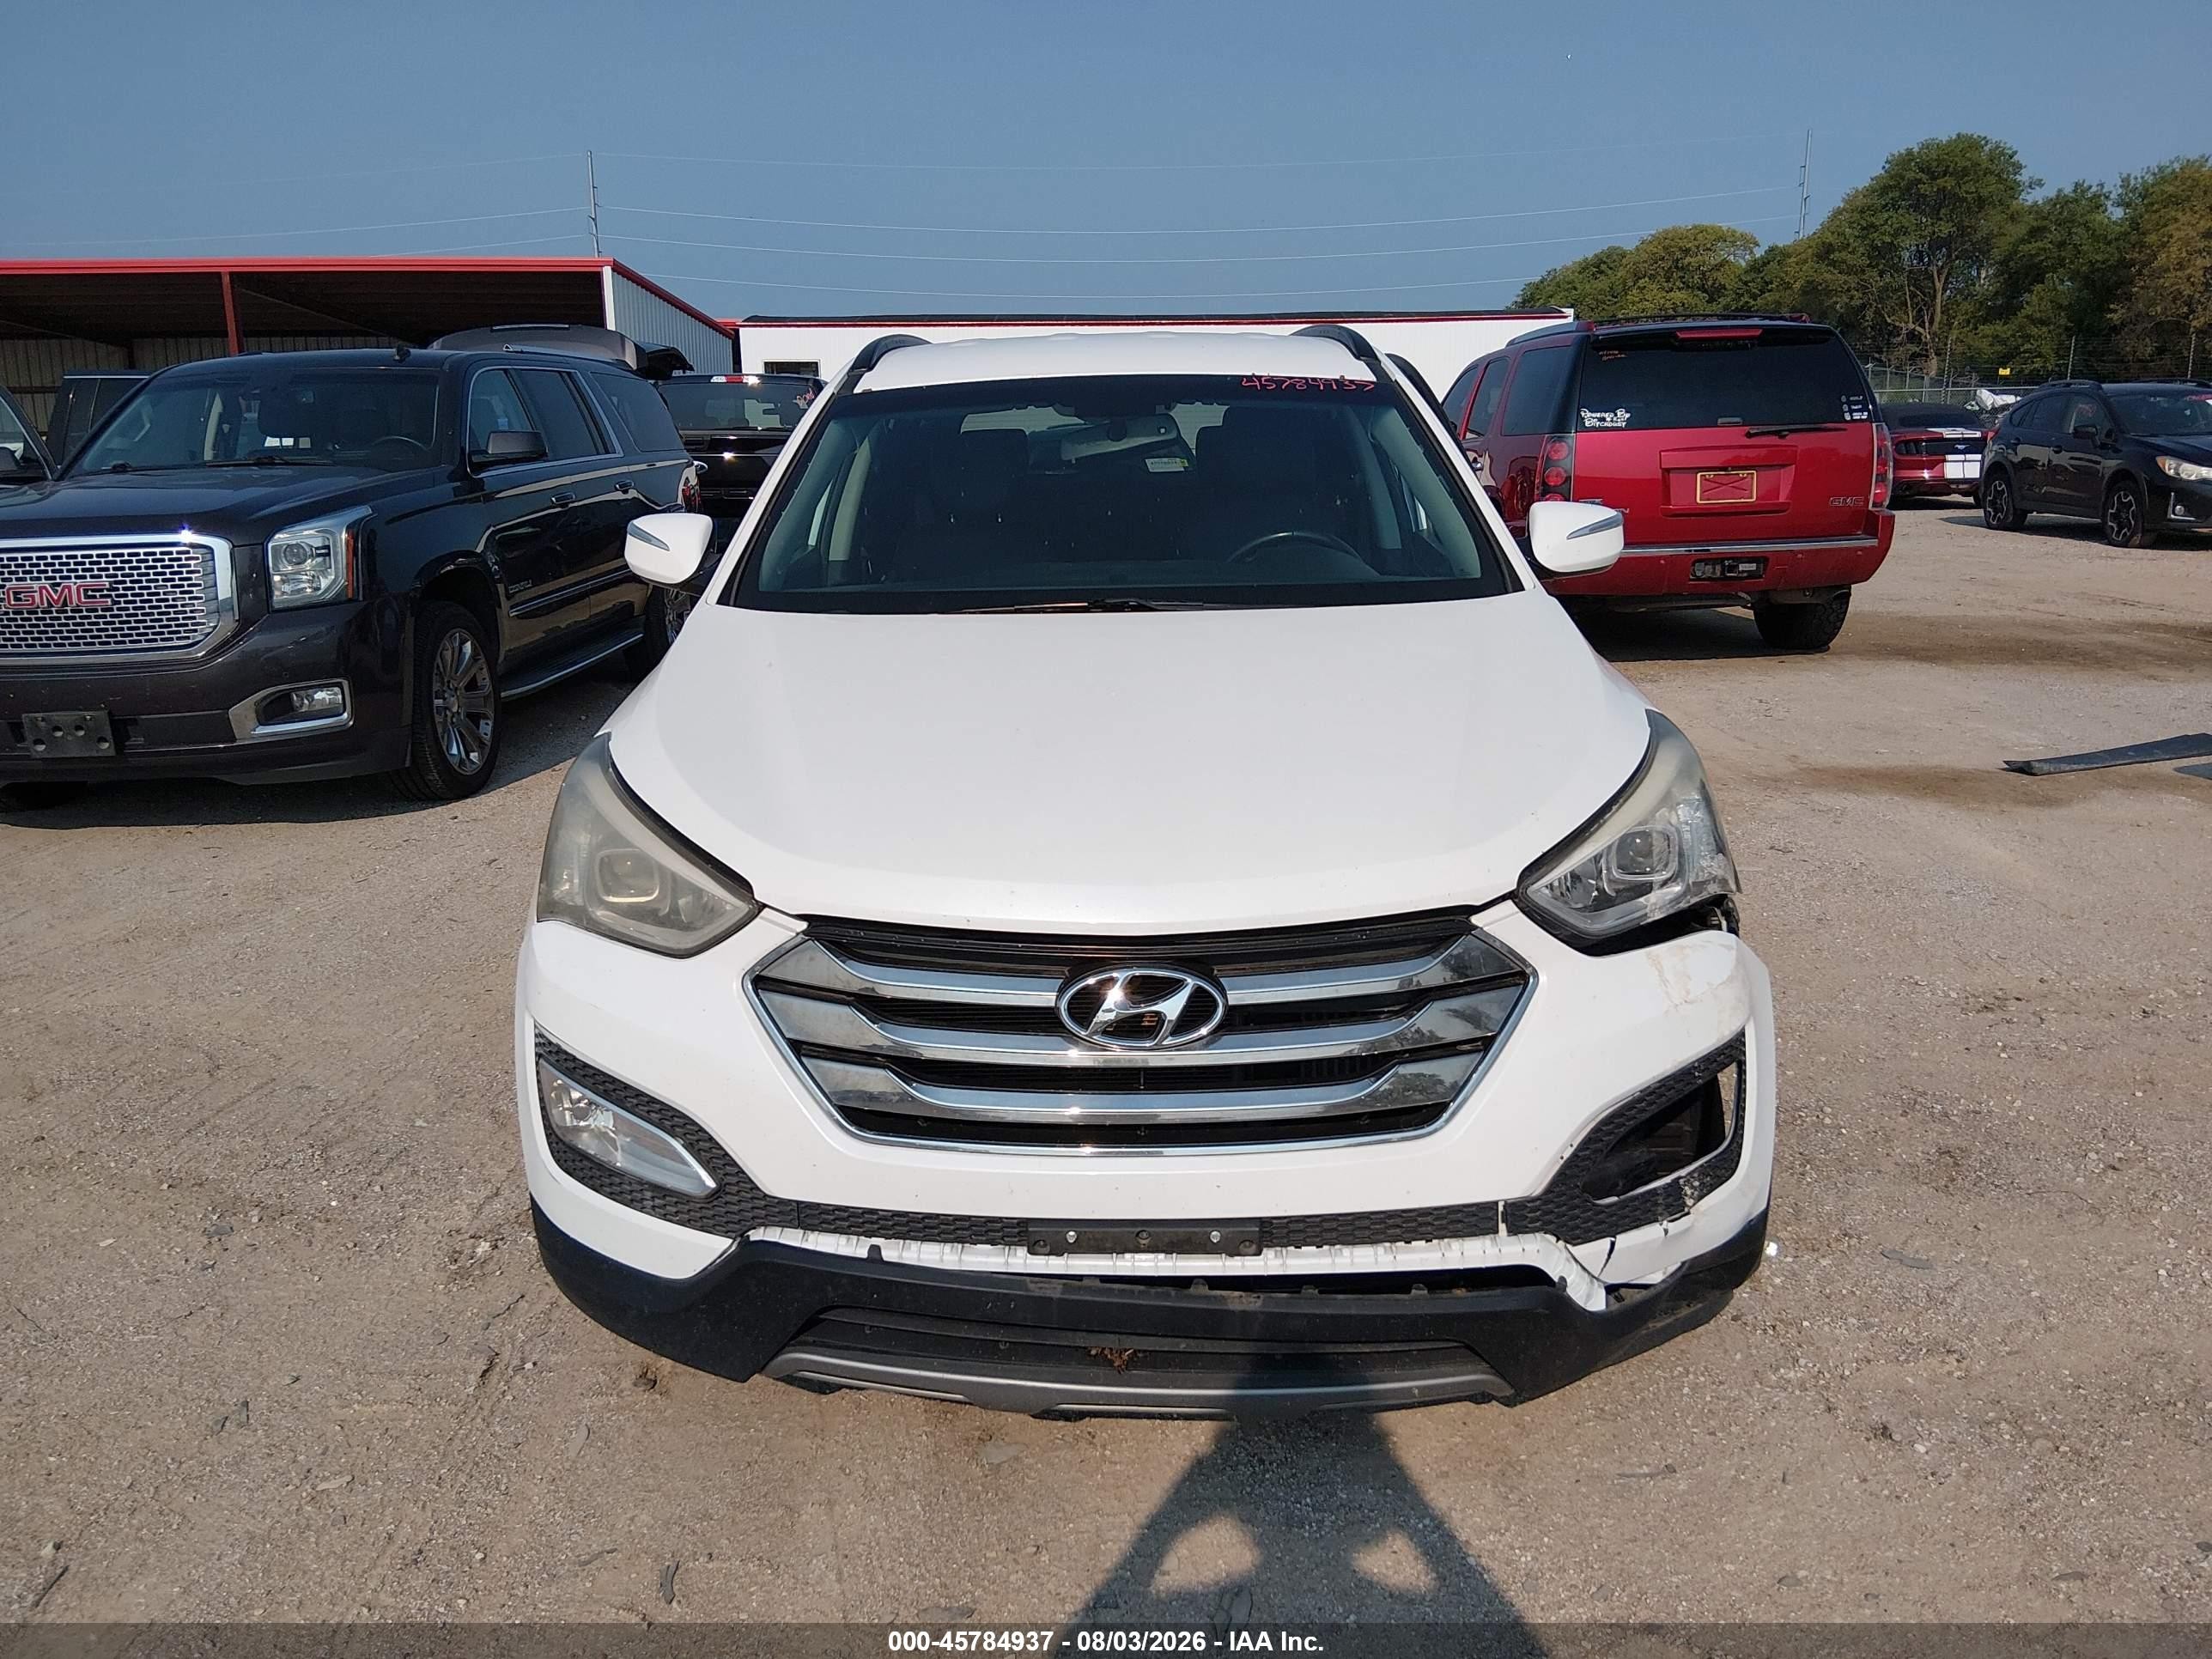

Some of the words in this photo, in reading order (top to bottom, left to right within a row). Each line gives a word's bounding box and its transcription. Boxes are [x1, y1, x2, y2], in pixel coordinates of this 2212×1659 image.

[1242, 377, 1375, 392] 45784937
[1829, 496, 1864, 507] GMC
[4, 582, 111, 609] GMC
